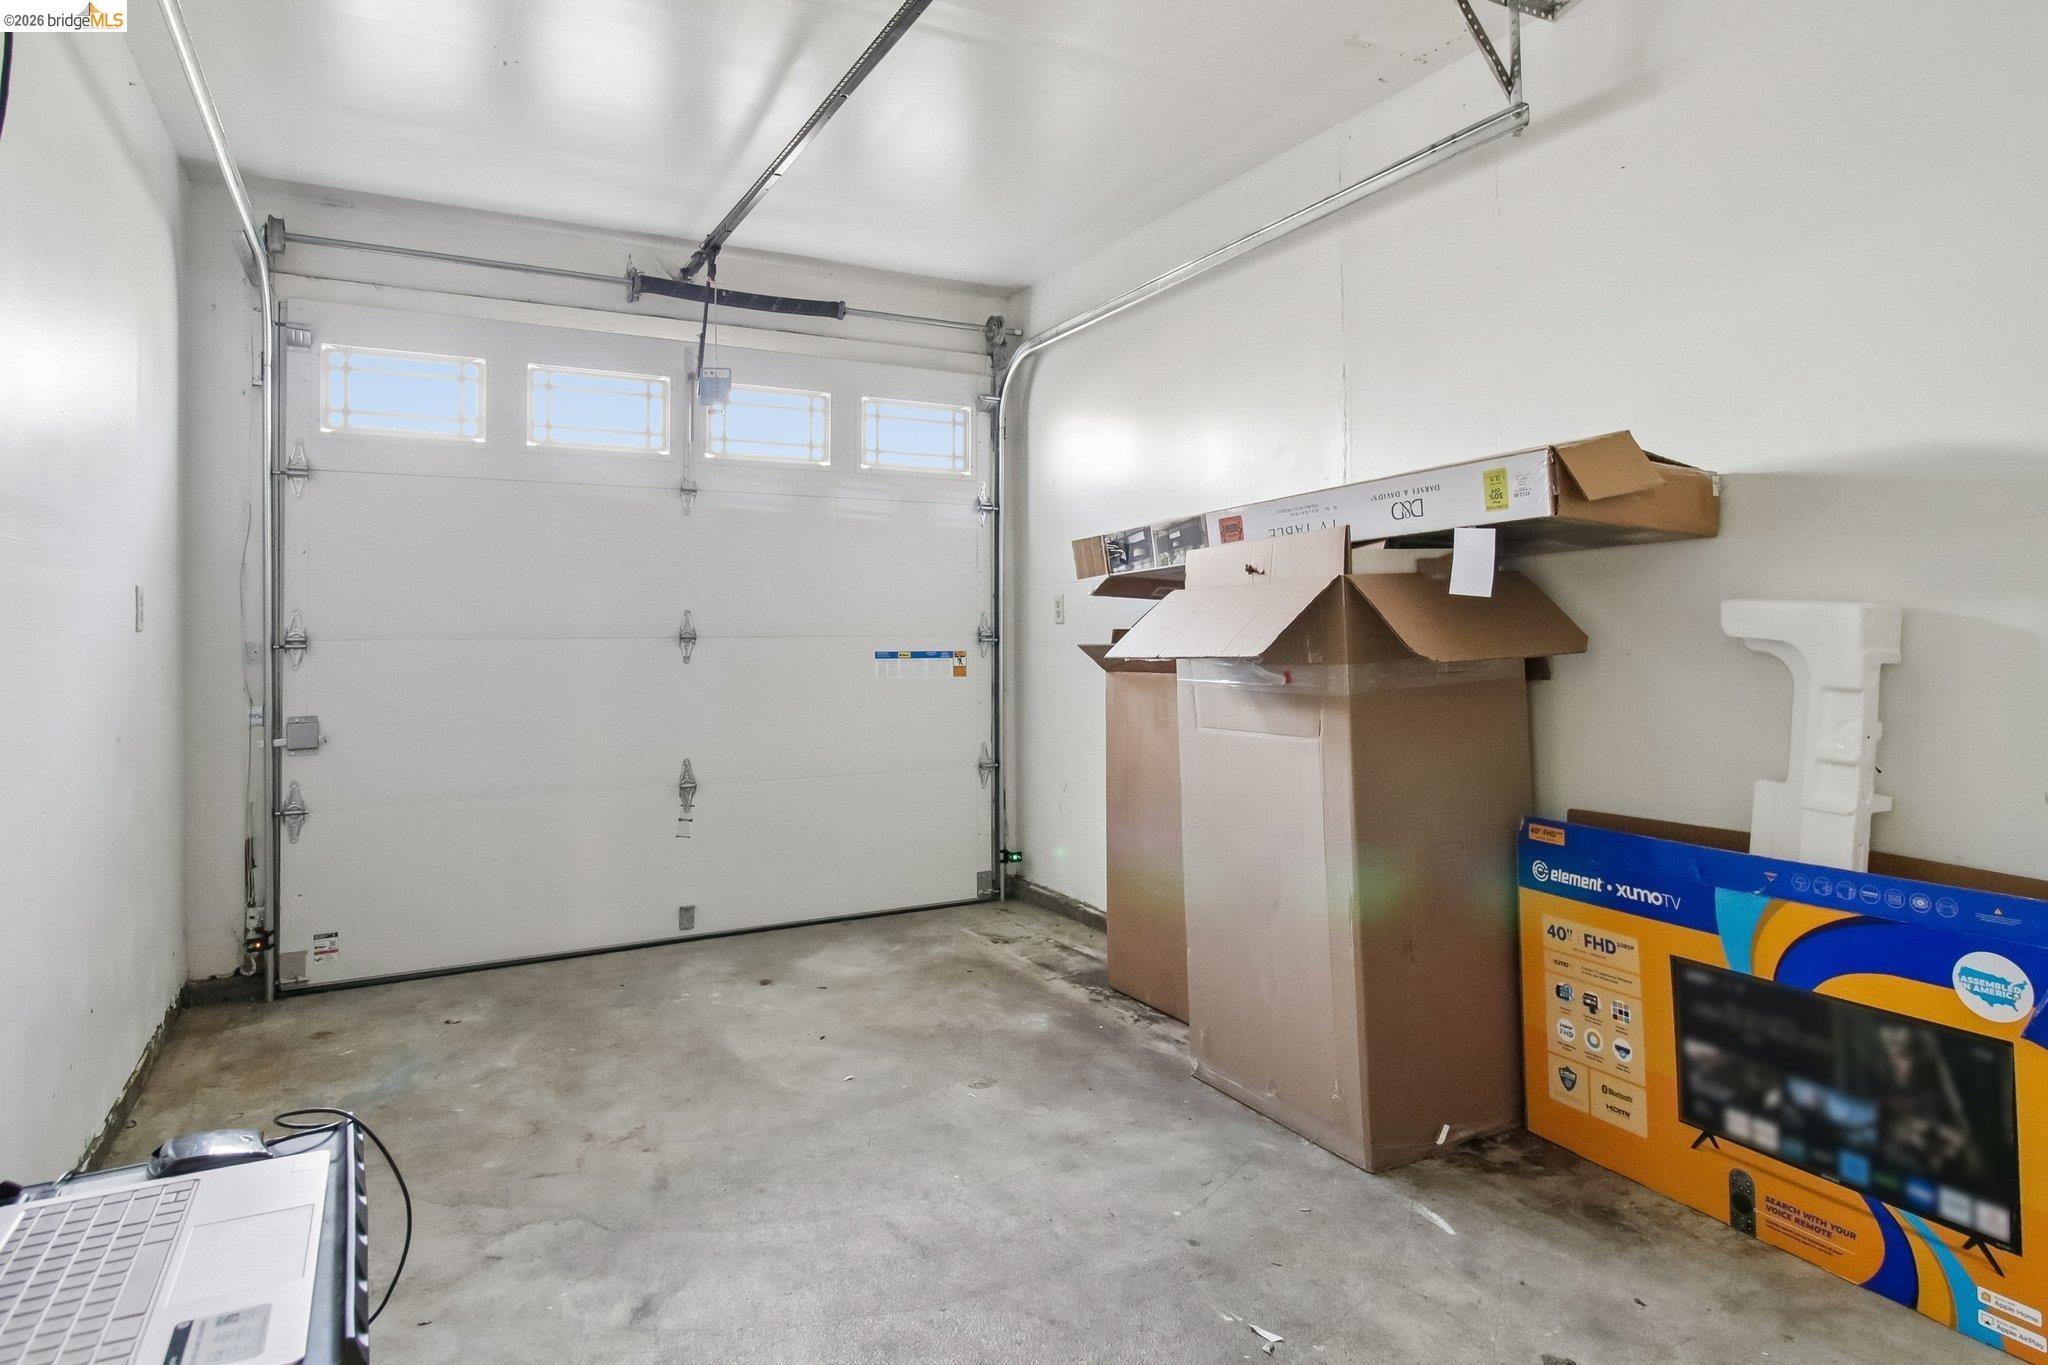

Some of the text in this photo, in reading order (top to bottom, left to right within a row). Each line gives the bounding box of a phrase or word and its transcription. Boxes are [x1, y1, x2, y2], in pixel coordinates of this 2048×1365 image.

[1391, 497, 1424, 521] D&D
[1550, 868, 1602, 892] element
[1583, 933, 1617, 955] FHD
[1960, 974, 2021, 994] ASSEMBLED
[1972, 985, 2022, 1000] AMERICA
[1765, 1195, 1801, 1215] SEARCH
[1803, 1211, 1828, 1227] WITH
[1830, 1222, 1857, 1240] YOUR
[1765, 1204, 1793, 1221] VOICE
[1794, 1217, 1833, 1239] REMOTE
